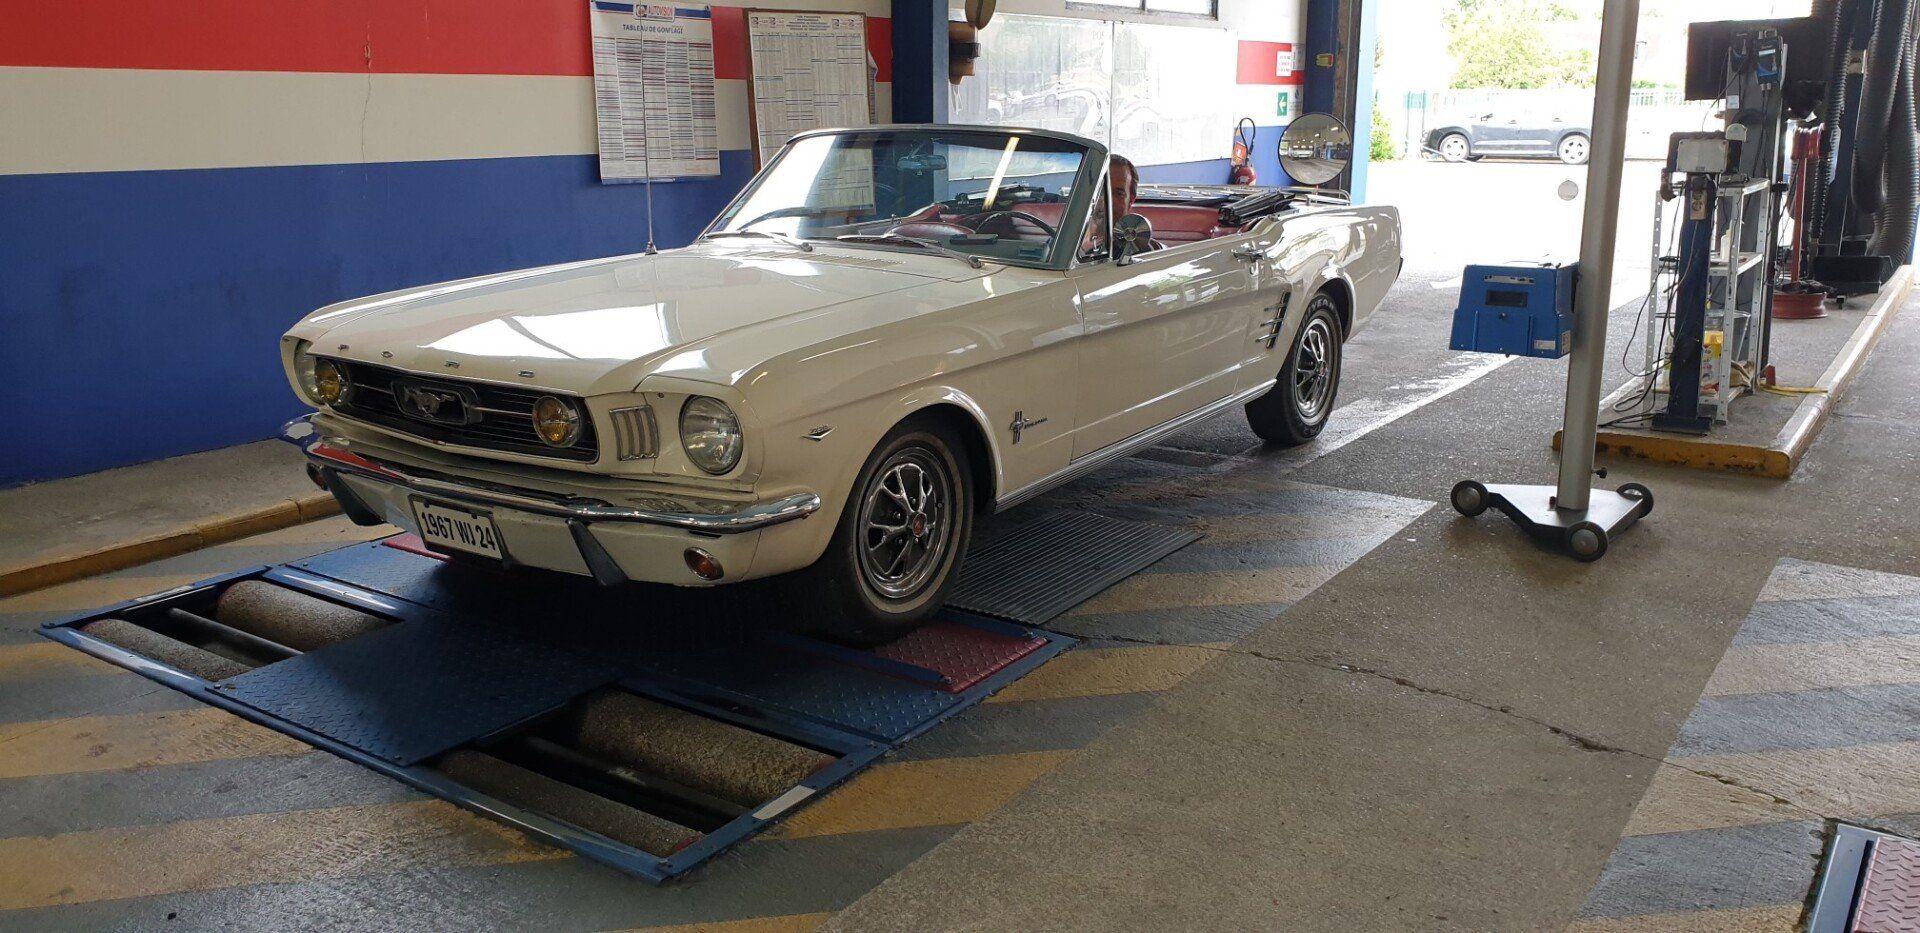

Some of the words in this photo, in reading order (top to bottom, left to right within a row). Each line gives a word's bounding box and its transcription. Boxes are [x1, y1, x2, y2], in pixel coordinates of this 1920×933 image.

[622, 23, 648, 33] TABLEAU
[648, 25, 656, 33] DE
[421, 512, 454, 540] 1967
[454, 519, 476, 546] WJ
[475, 525, 496, 550] 24
